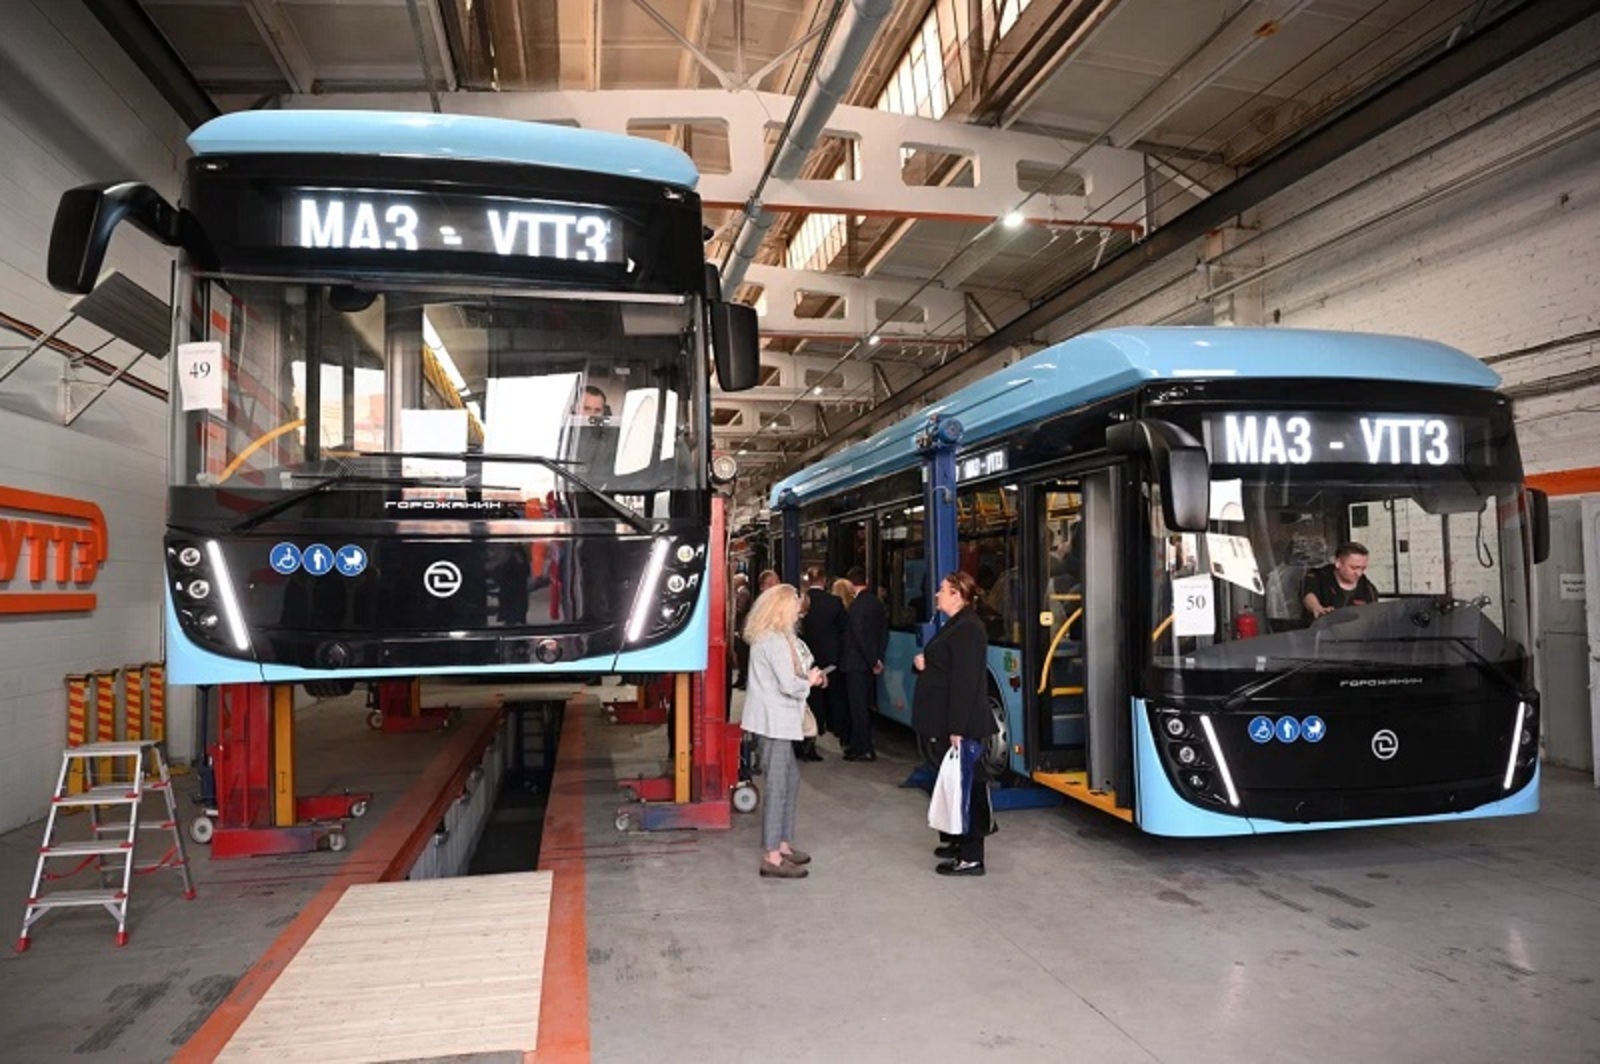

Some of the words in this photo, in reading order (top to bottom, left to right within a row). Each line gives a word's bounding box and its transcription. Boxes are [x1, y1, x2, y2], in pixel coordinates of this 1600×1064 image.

[301, 199, 418, 250] МАЗ
[189, 362, 211, 378] 49
[1225, 415, 1312, 464] МАЗ
[1186, 595, 1206, 610] 50
